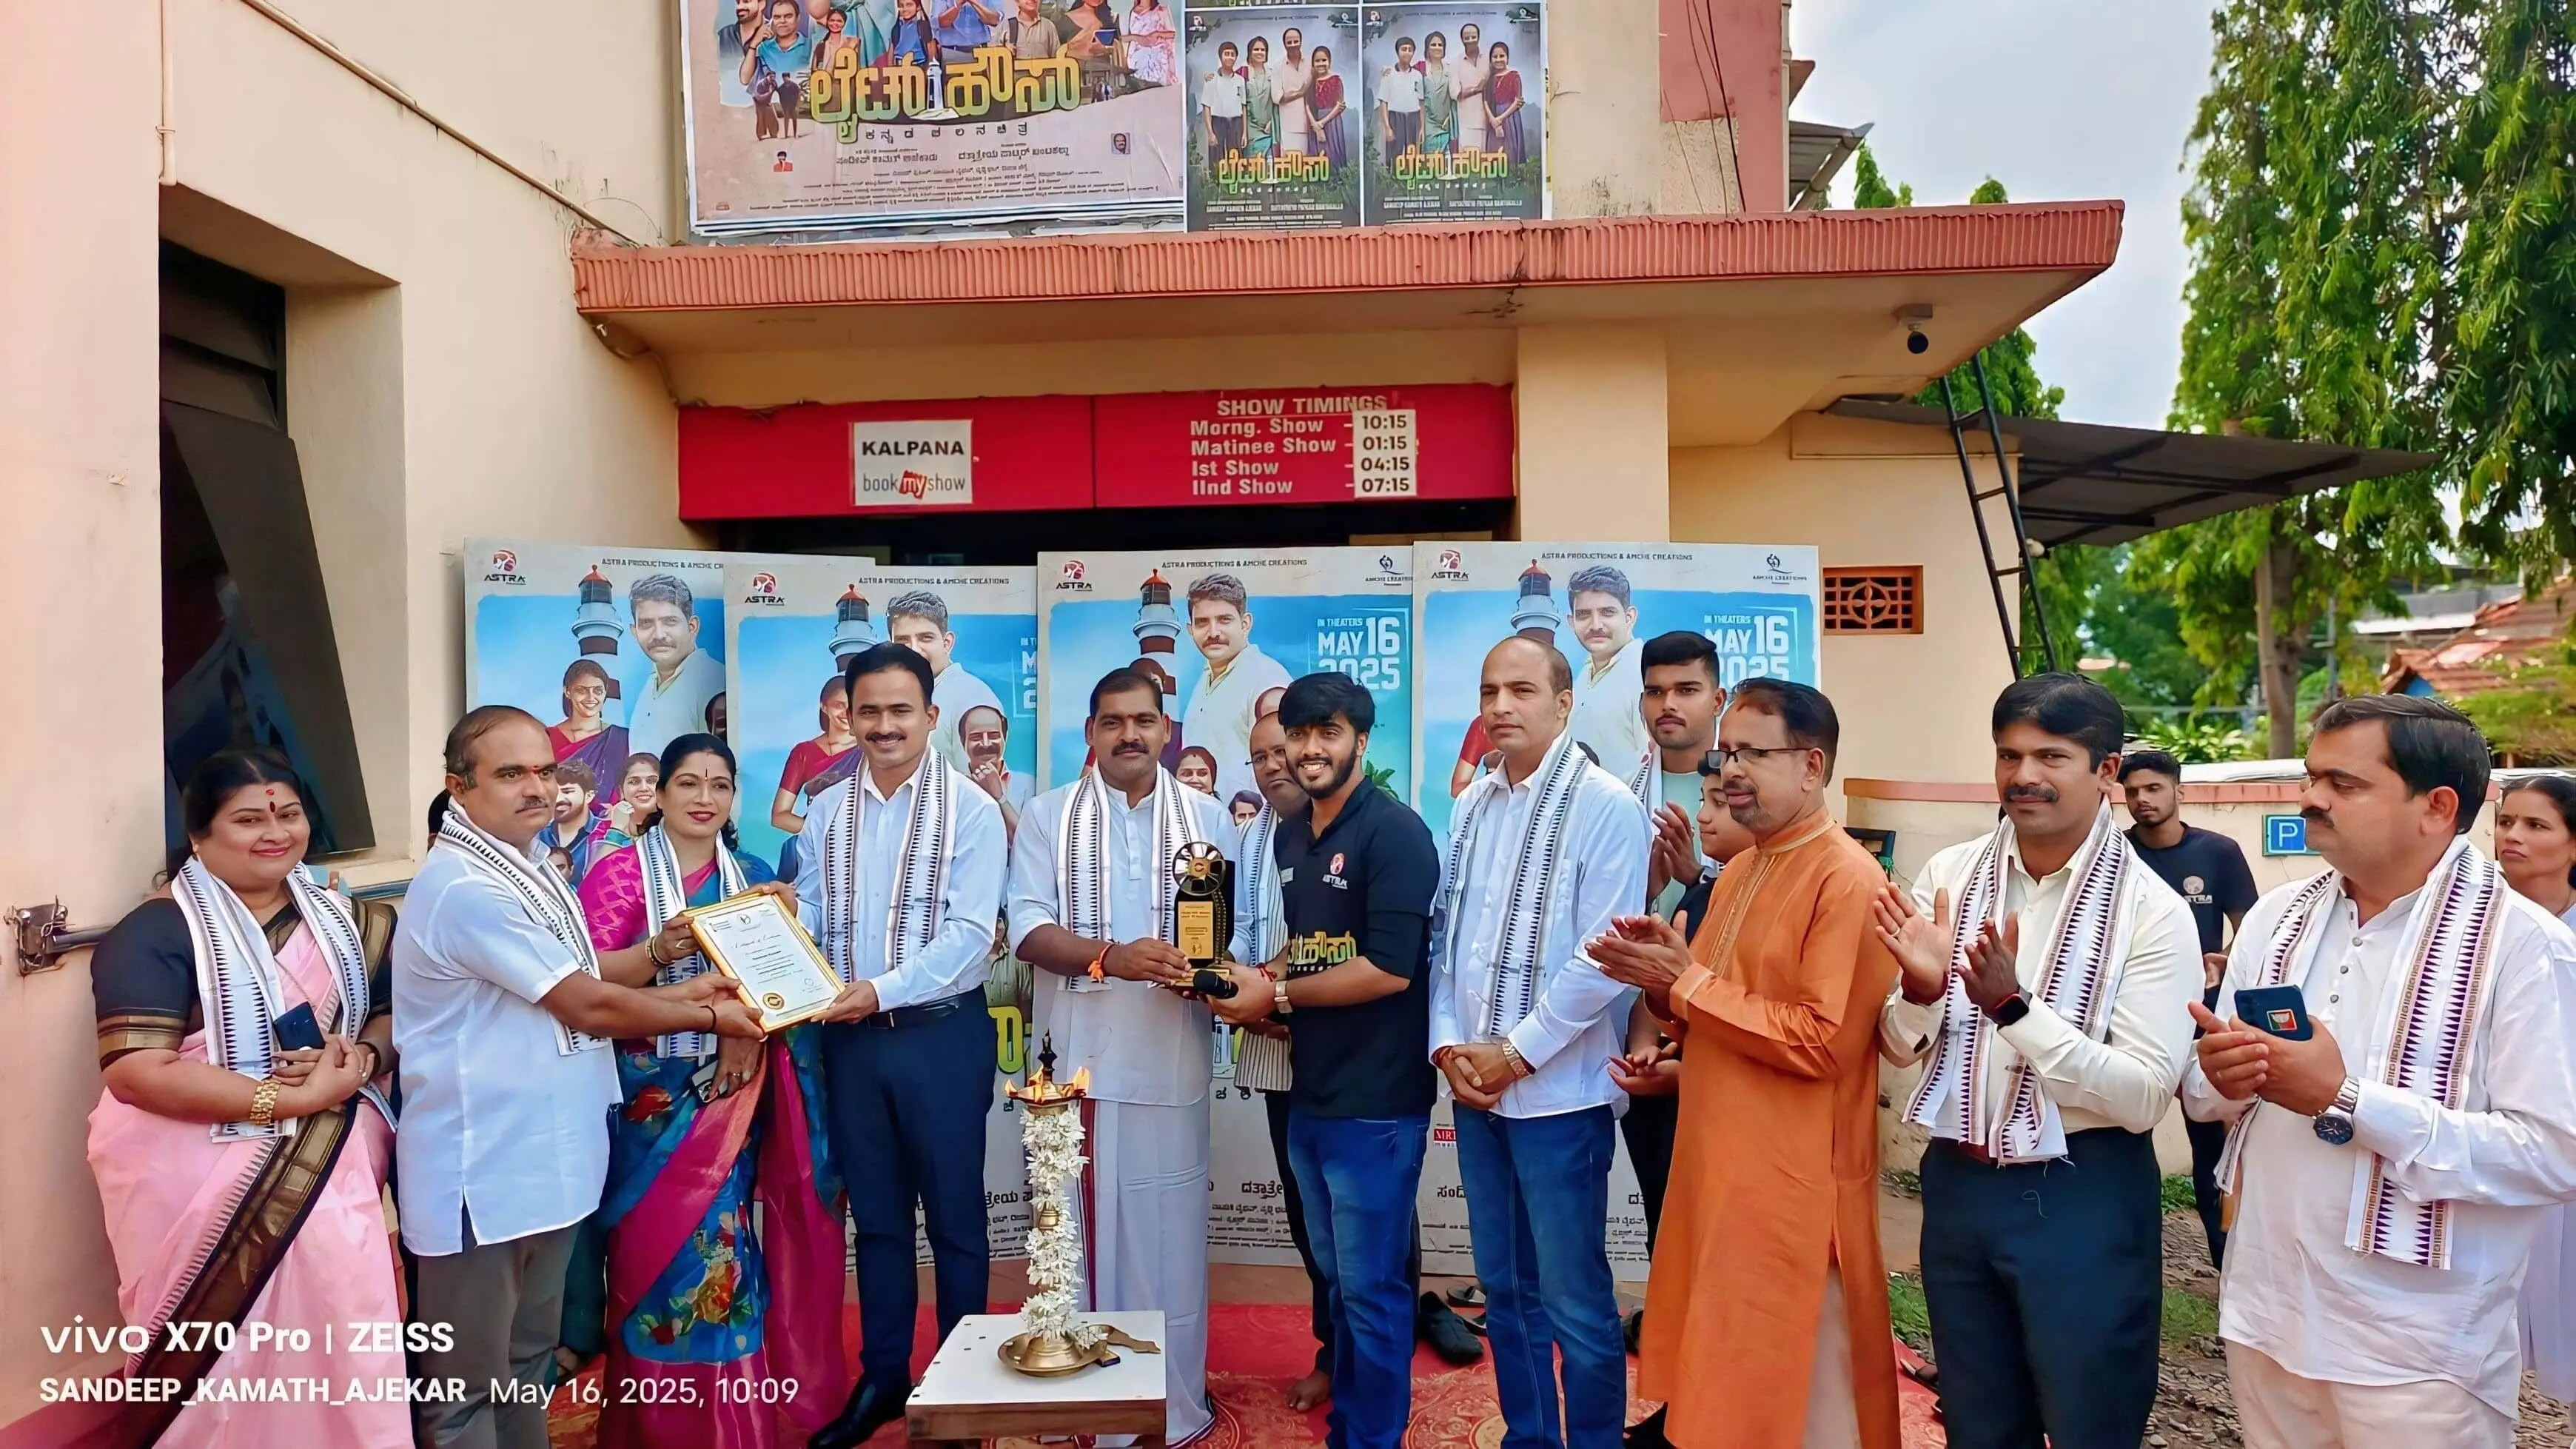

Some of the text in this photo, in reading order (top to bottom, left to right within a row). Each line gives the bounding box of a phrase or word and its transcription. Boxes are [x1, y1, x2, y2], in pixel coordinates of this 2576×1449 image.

[1217, 395, 1388, 416] SHOW TIMINGS
[1190, 420, 1262, 438] Morng.
[1269, 418, 1324, 434] Show
[1362, 415, 1406, 429] 10:15
[862, 441, 965, 456] KALPANA
[1190, 439, 1275, 456] Matinee
[1282, 437, 1336, 454] Show
[1362, 435, 1406, 450] 01:15
[1225, 459, 1279, 475] Show
[1361, 456, 1409, 472] 04:15
[1238, 478, 1292, 495] Show
[1361, 478, 1409, 493] 07:15
[484, 574, 526, 583] ASTRA
[1431, 572, 1469, 580] ASTRA
[1056, 581, 1092, 591] ASTRA
[745, 595, 785, 603] ASTRA
[1326, 618, 1364, 627] THEATERS
[1318, 616, 1401, 657] MAY 16
[1705, 615, 1789, 655] MAY 16
[2278, 822, 2299, 848] P
[1241, 1179, 1284, 1199] ದತ್ತಾತ್ರೇ
